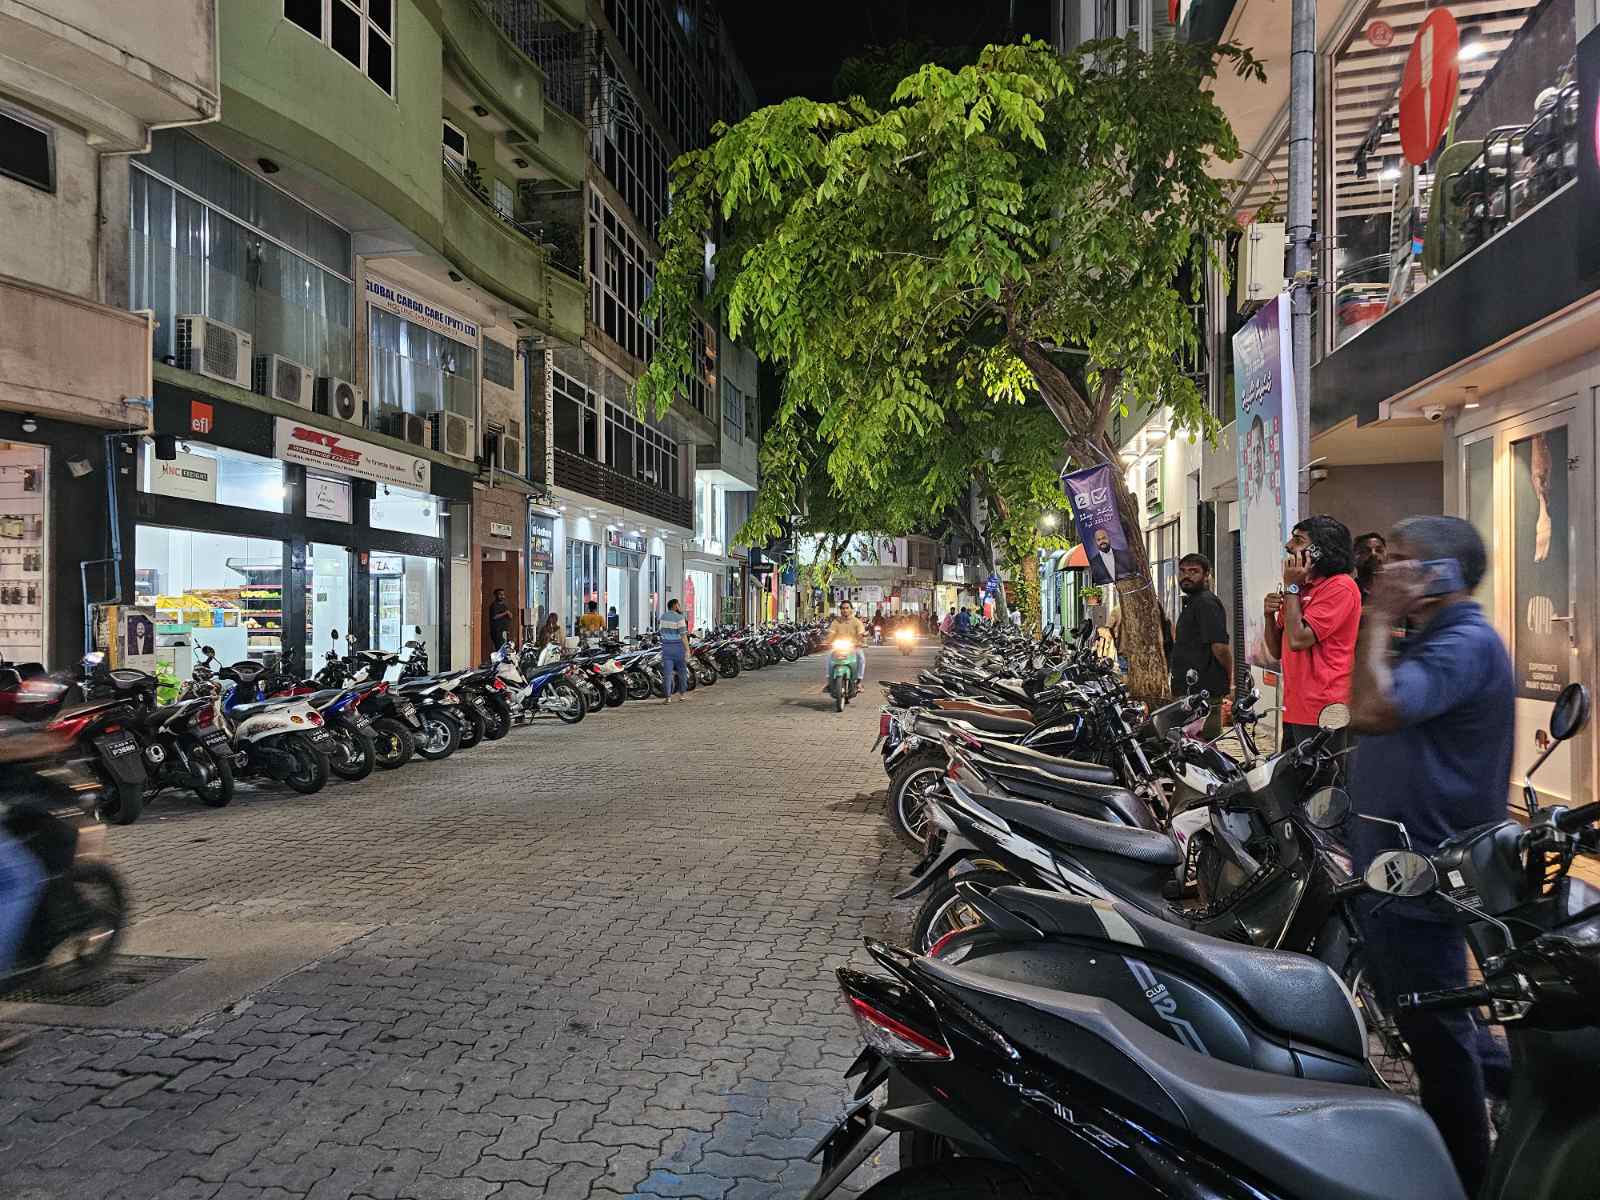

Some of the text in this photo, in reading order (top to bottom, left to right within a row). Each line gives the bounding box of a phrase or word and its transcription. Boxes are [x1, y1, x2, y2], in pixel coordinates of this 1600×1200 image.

[365, 279, 395, 302] GLOBAL
[396, 293, 423, 314] CARGO
[424, 306, 444, 324] CARE
[444, 314, 464, 332] (PVT)
[464, 324, 476, 337] LTD
[192, 418, 208, 434] efl
[1078, 495, 1087, 507] 2
[1145, 983, 1166, 998] CLUB
